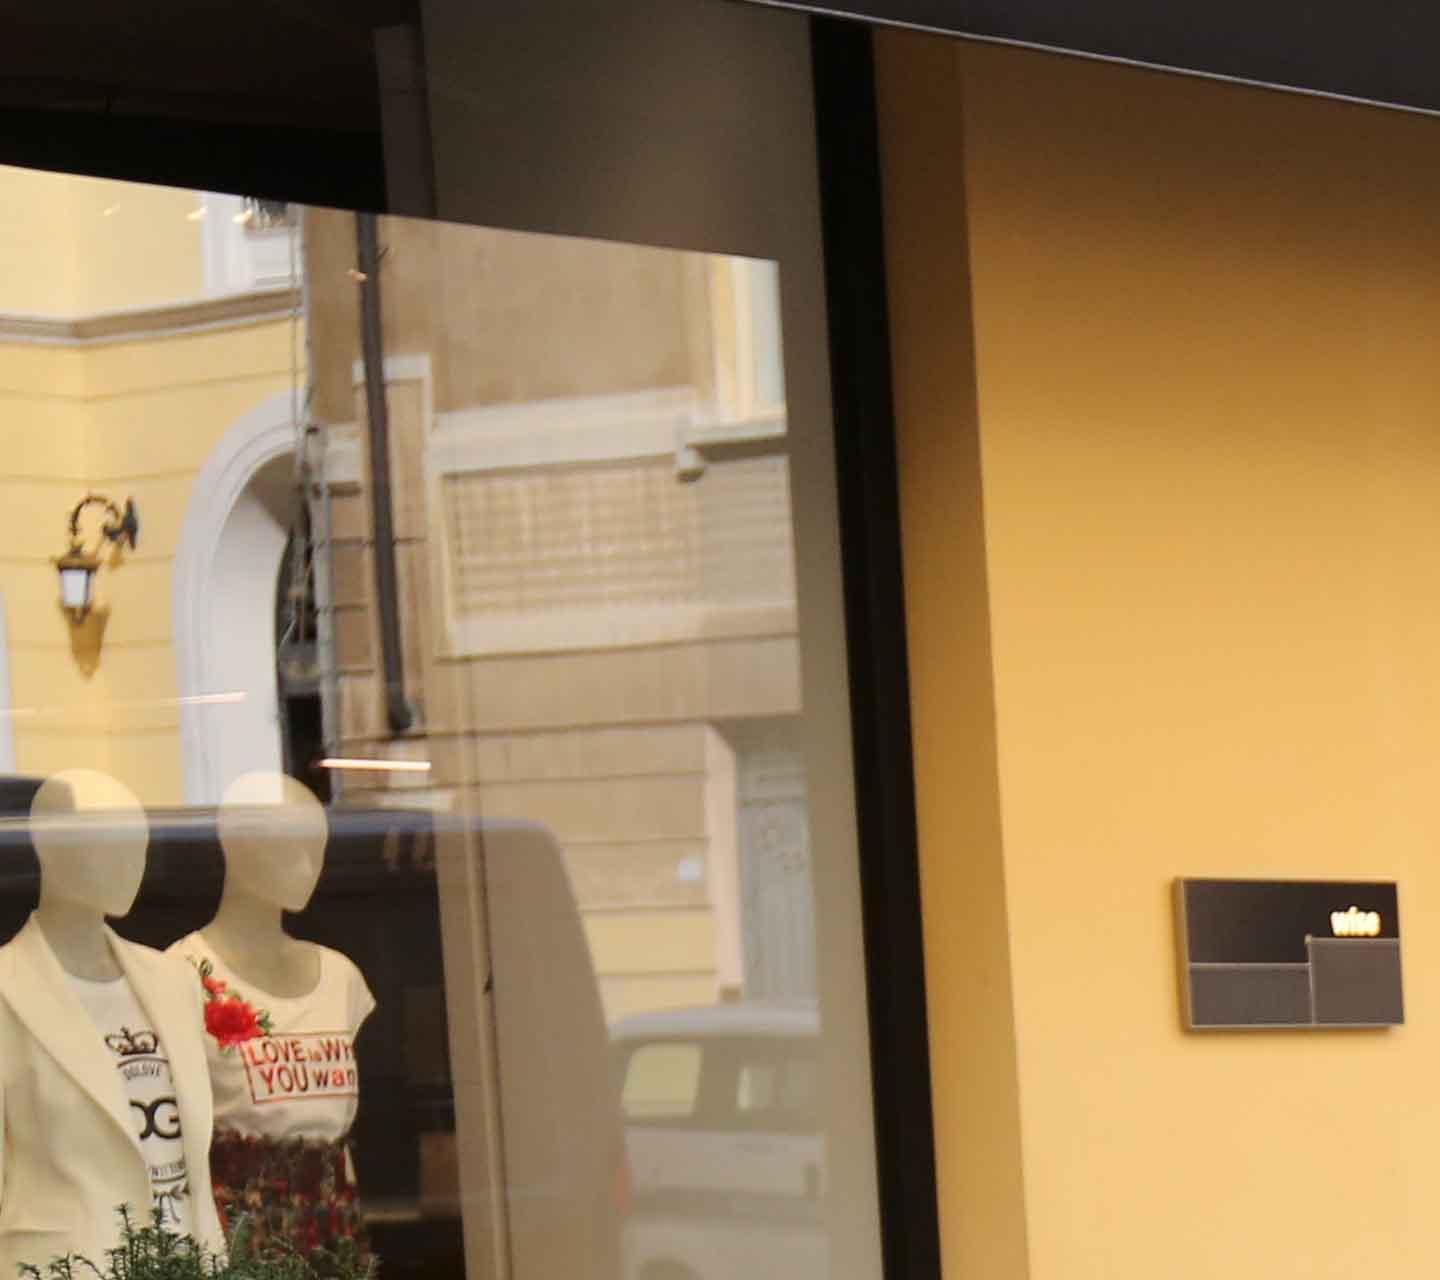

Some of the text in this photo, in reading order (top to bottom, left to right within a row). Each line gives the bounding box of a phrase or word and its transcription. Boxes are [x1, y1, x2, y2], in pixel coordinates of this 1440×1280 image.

[1330, 905, 1381, 937] wise
[250, 1040, 305, 1066] LOVE
[259, 1066, 309, 1095] YOU
